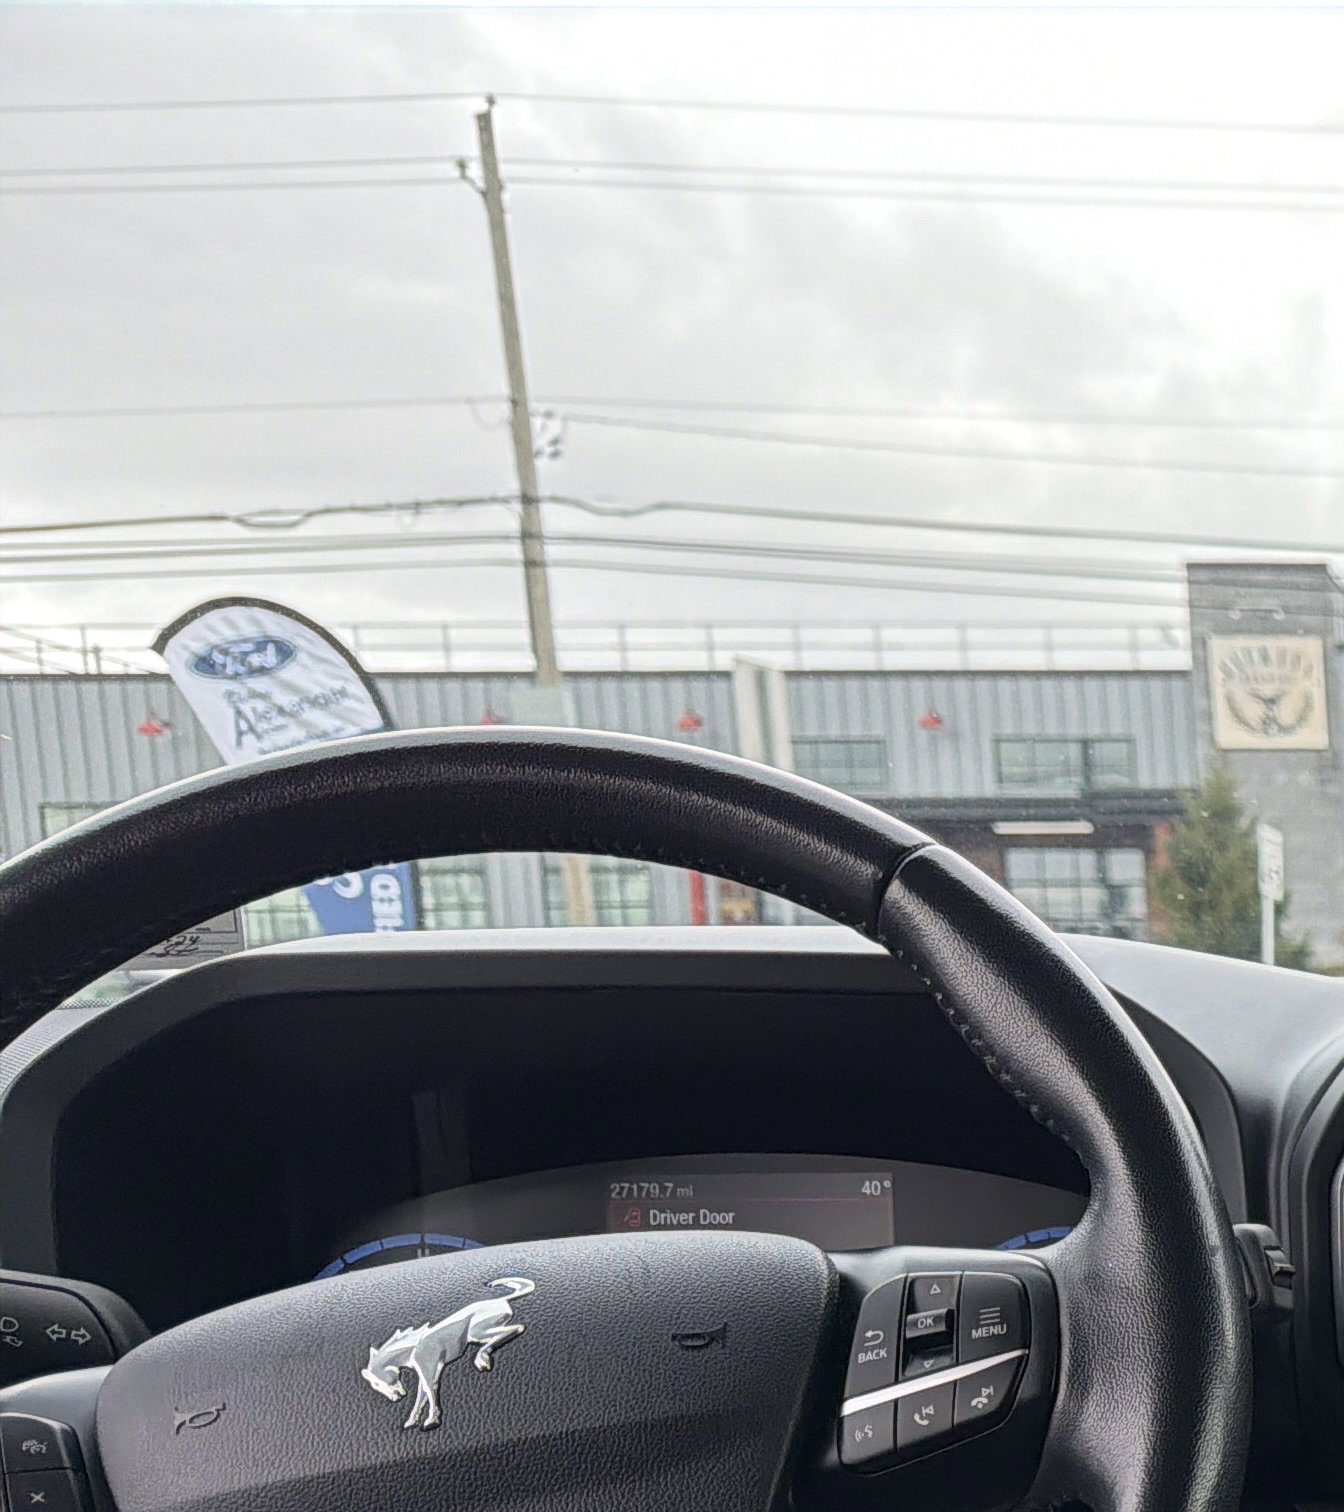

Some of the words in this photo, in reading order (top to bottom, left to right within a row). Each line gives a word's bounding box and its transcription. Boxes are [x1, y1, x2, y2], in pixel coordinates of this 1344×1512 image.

[609, 1183, 674, 1199] 27179.7
[649, 1209, 695, 1226] Driver
[699, 1209, 736, 1226] Door
[917, 1317, 935, 1330] OK
[971, 1323, 1008, 1341] MENU
[857, 1351, 888, 1364] BACK
